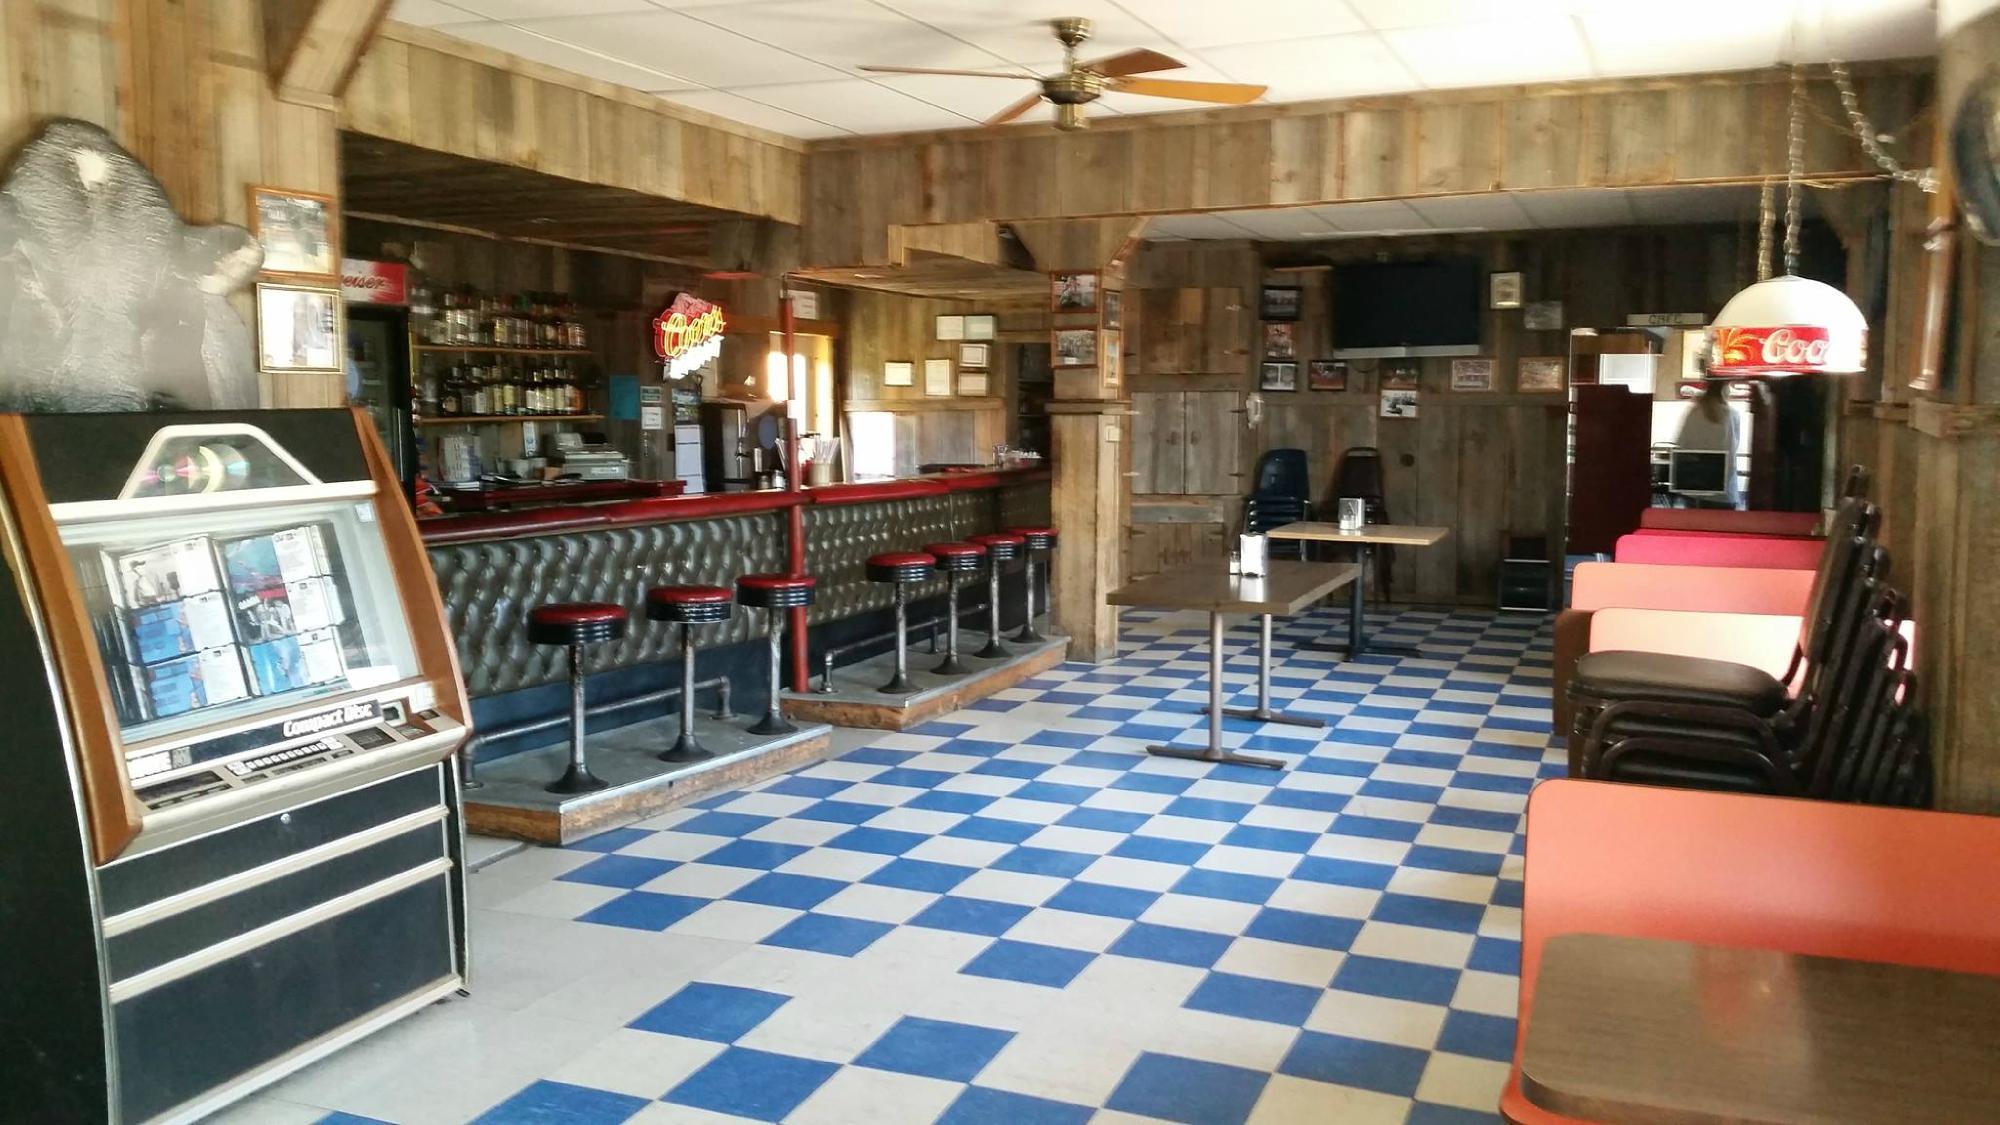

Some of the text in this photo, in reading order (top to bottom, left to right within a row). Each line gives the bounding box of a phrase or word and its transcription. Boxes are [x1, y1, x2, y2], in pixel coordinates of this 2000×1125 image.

[341, 271, 385, 288] eiser
[283, 704, 373, 737] Compact Disc
